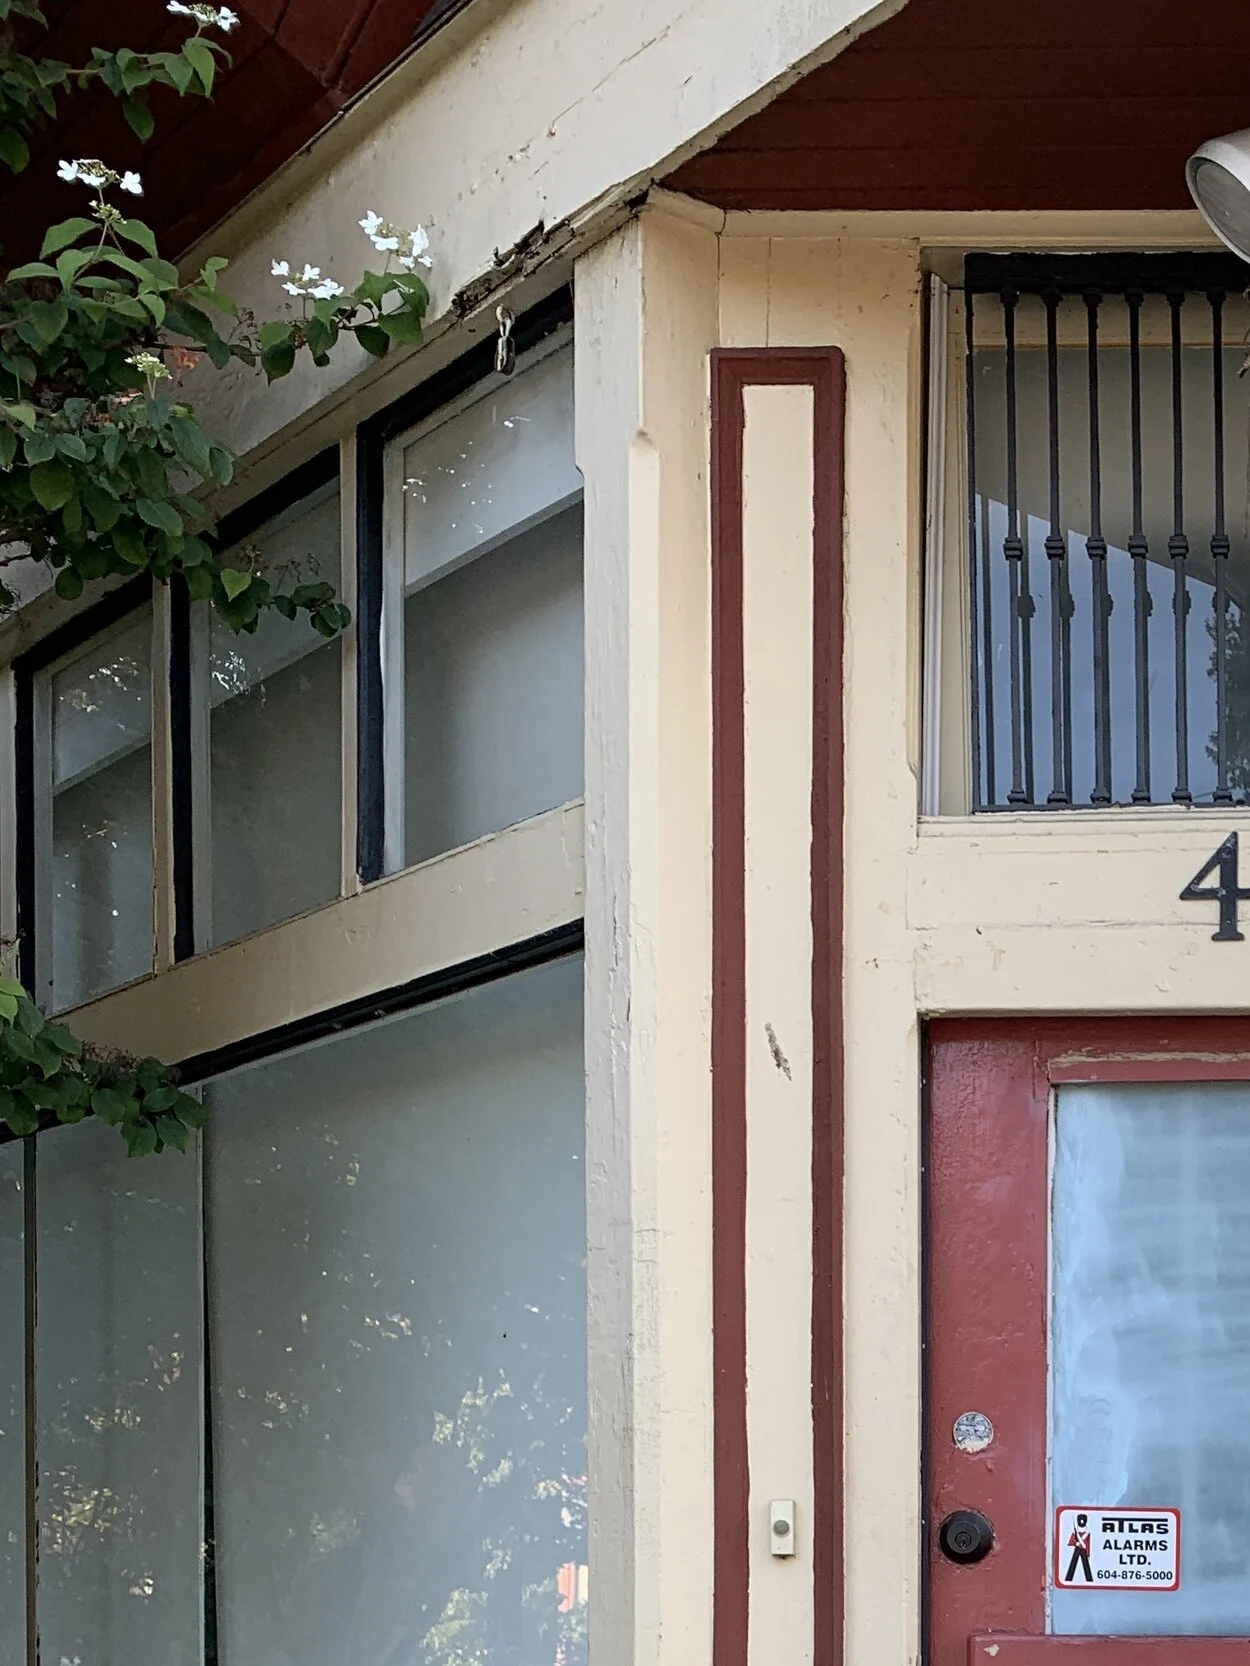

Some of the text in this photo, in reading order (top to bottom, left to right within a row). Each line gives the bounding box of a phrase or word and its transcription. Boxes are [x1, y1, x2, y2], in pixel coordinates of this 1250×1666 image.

[1101, 1517, 1169, 1534] ATLAS
[1102, 1539, 1168, 1551] ALARMS
[1119, 1554, 1151, 1565] LTD.
[1097, 1569, 1173, 1580] 604-876-5000
